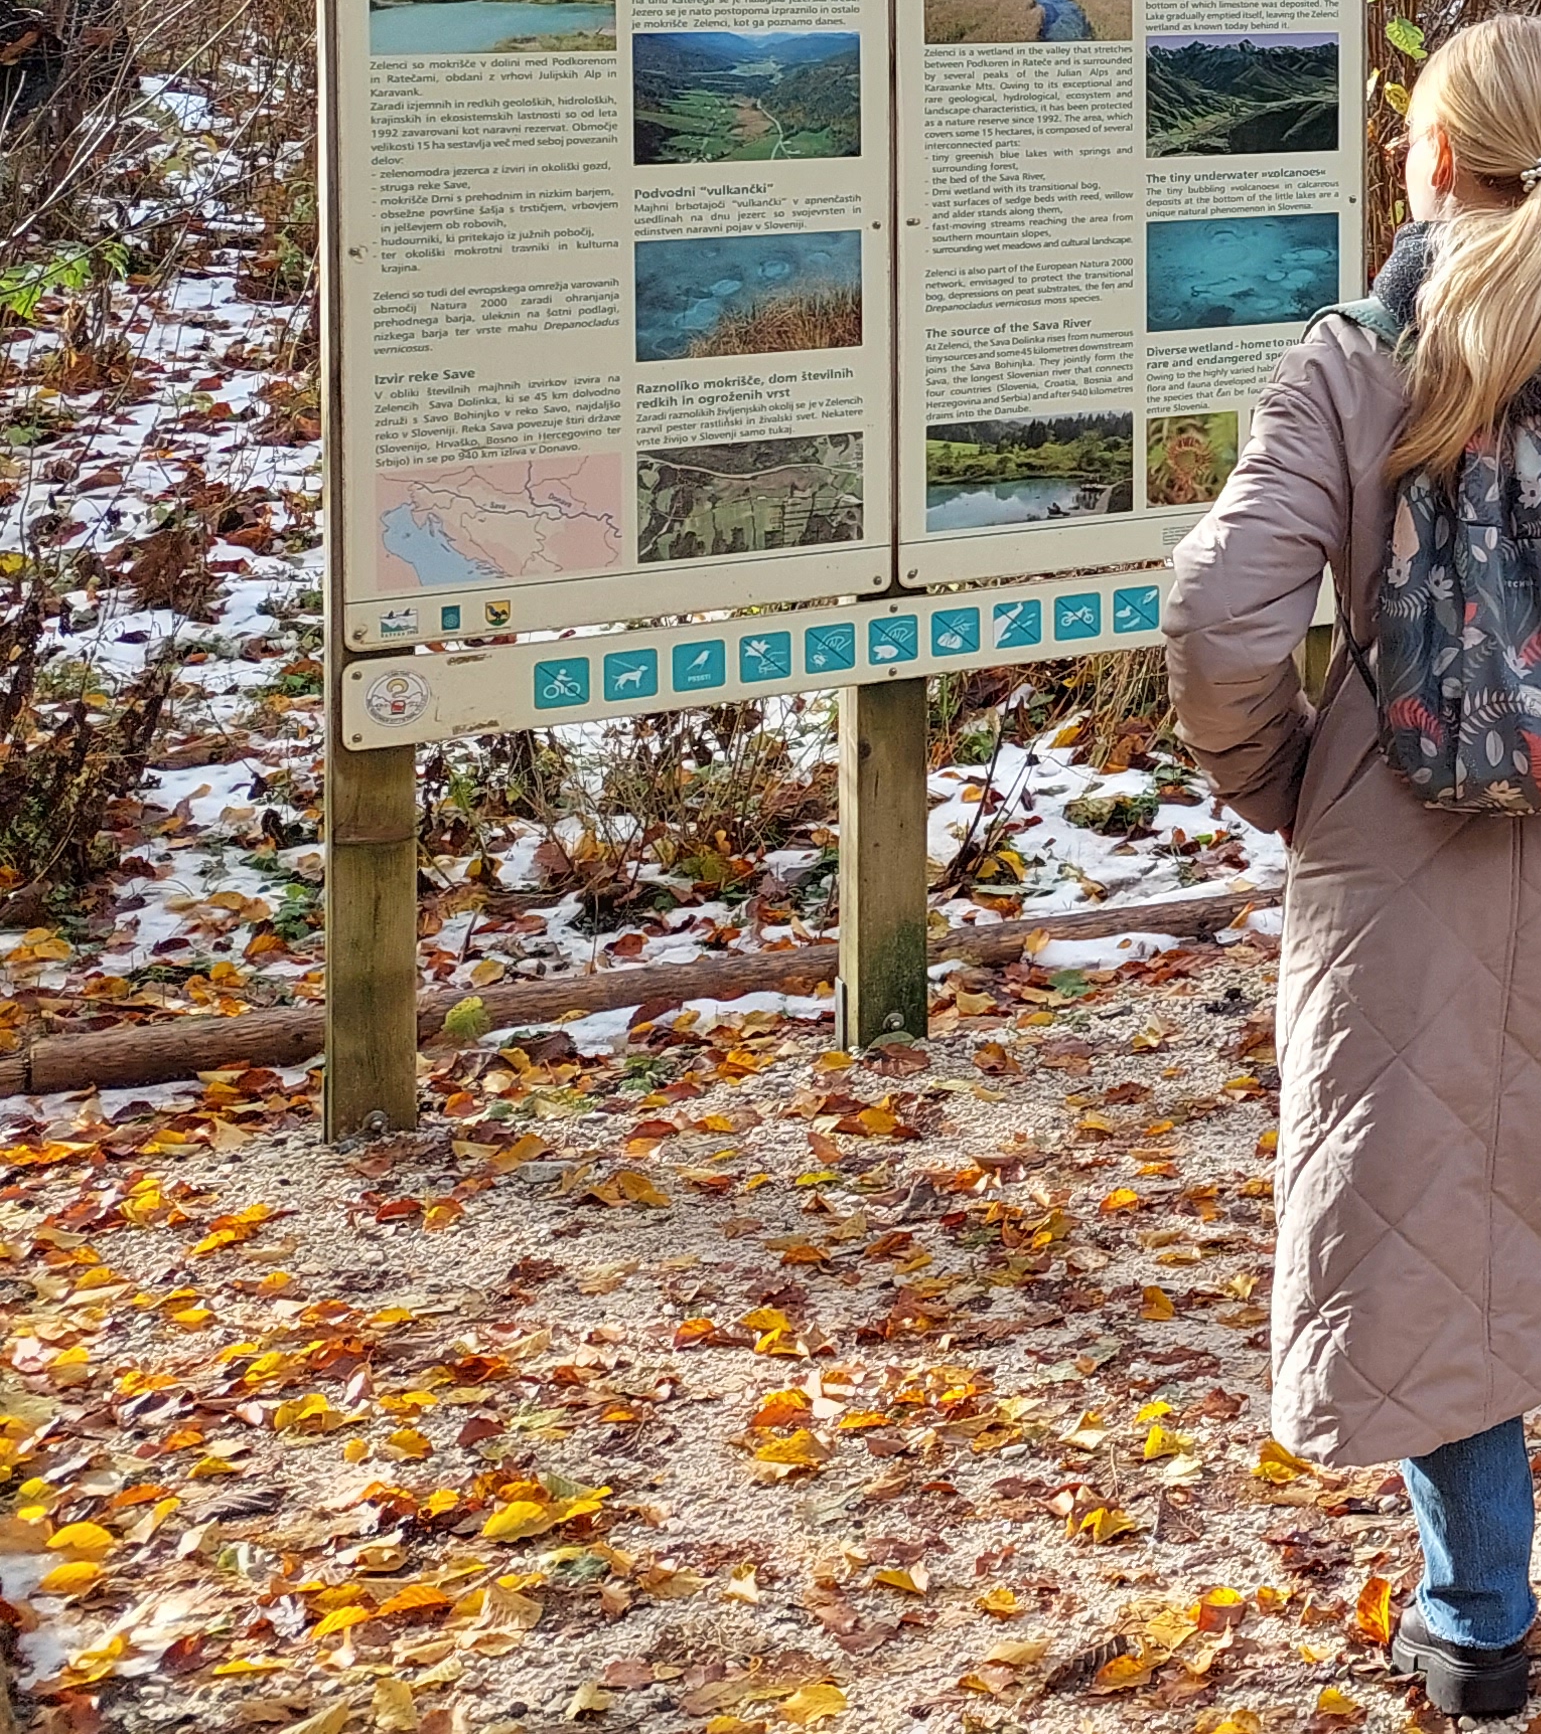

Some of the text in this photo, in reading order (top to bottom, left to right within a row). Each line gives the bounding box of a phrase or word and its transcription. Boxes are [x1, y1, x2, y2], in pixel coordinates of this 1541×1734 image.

[538, 70, 578, 81] Julijskih
[1169, 172, 1191, 184] tiny
[634, 186, 695, 199] Podvodni
[1188, 341, 1233, 353] wetland
[1196, 351, 1262, 365] endangered
[374, 369, 475, 384] Izvir reke Save
[636, 368, 853, 394] Raznoliko mokrišče, dom številnih
[636, 396, 677, 409] redkih
[698, 390, 762, 405] ogroženih
